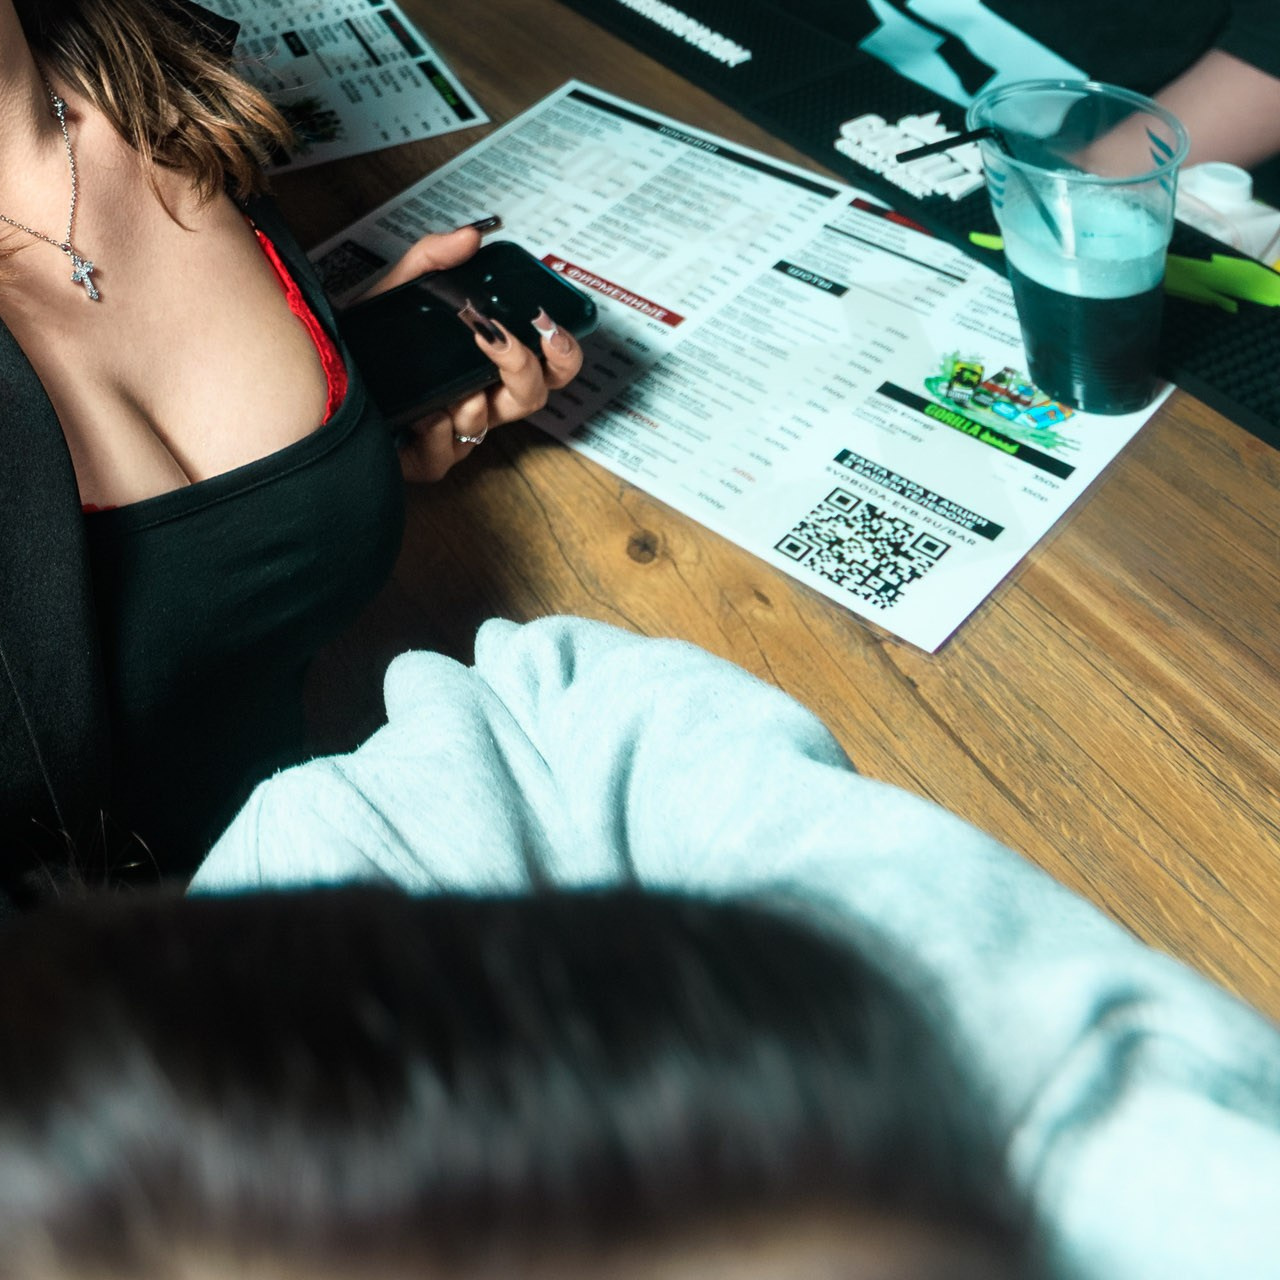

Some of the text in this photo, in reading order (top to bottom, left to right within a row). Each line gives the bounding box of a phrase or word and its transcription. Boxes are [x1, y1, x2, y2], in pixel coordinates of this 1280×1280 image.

[567, 267, 669, 320] ФИРМЕННЫЕ
[786, 265, 833, 290] ШОТЫ
[923, 403, 983, 436] GORILLA
[824, 465, 977, 547] SVOBODA-EKB.RU/BAR
[841, 460, 976, 530] В ВАШЕМ ТЕЛЕФОНЕ
[846, 453, 989, 527] КАРТА БАРА И АКЦИИ
